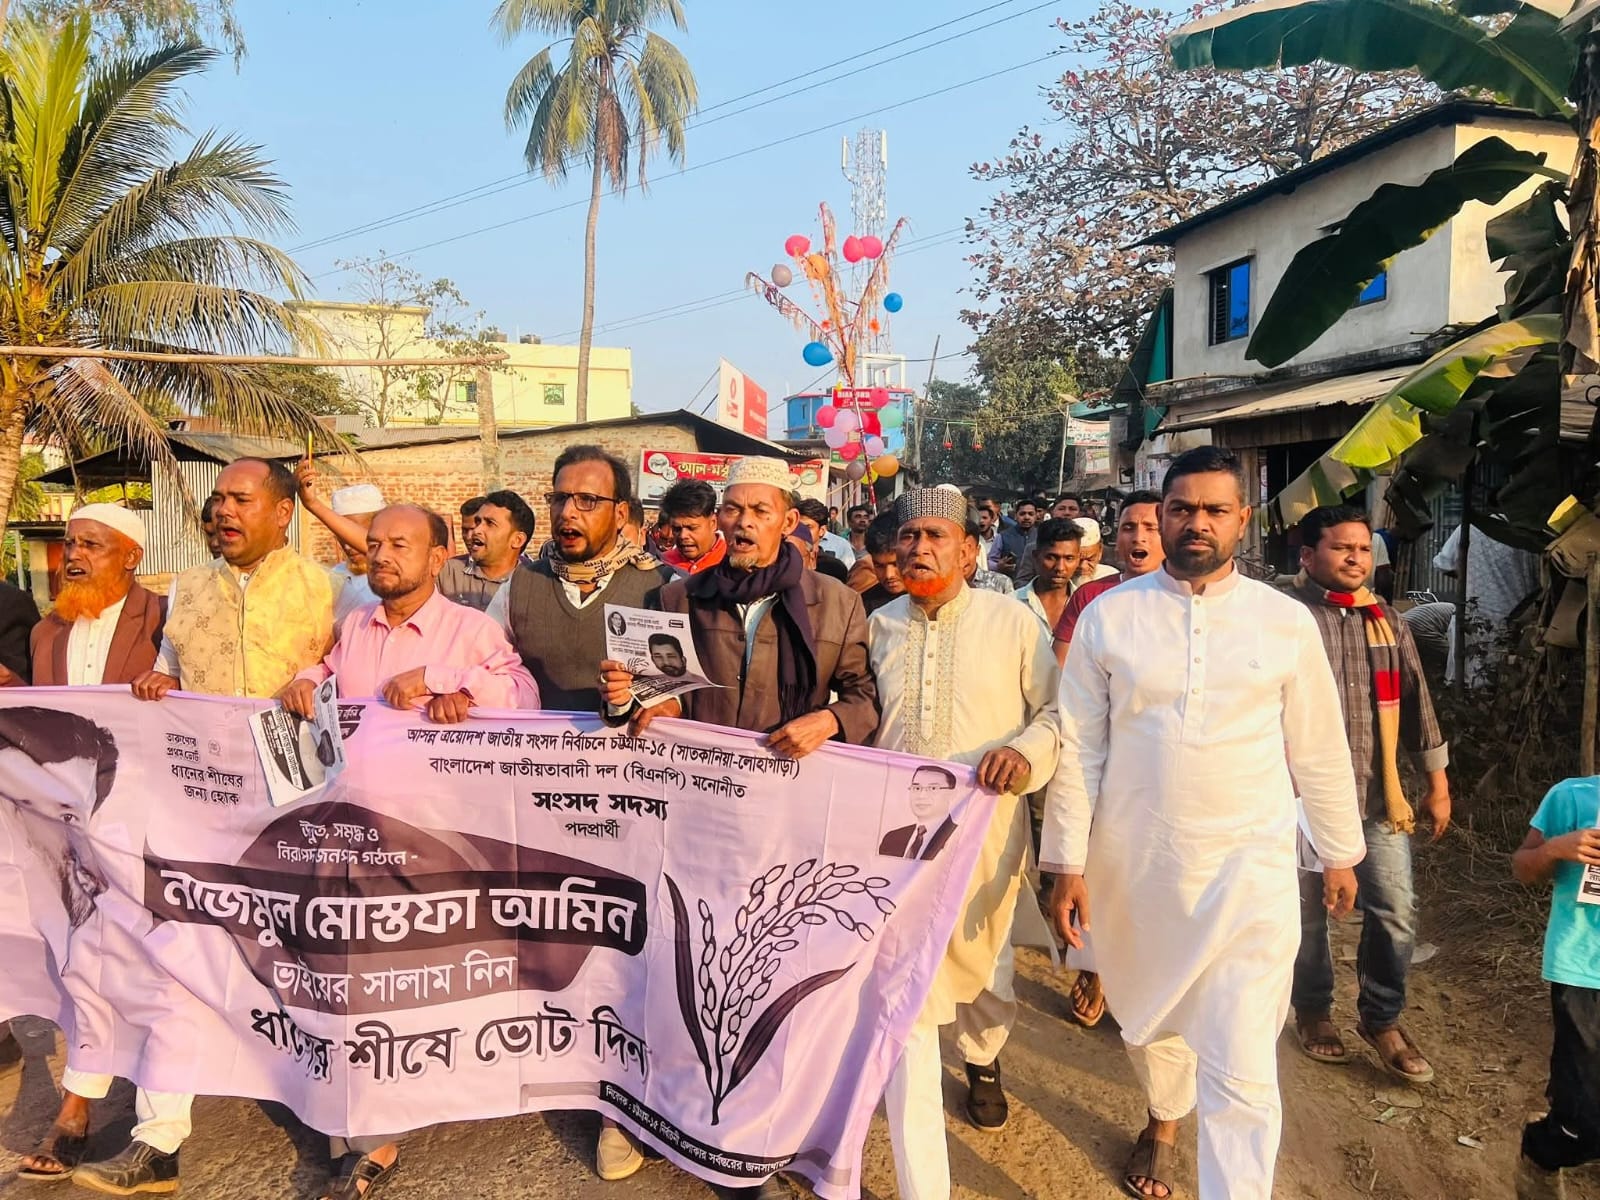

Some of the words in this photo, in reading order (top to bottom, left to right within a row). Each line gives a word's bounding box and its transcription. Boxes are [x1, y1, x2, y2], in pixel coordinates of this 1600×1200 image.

[407, 729, 440, 745] আসন্ন
[440, 730, 486, 745] ত্রয়োদশ
[487, 728, 524, 747] জাতীয়
[526, 733, 559, 750] সংসদ
[561, 731, 606, 751] নির্বাচনে
[171, 764, 205, 782] ধানের
[206, 766, 243, 788] শীষের
[429, 757, 495, 775] বাংলাদেশ
[499, 758, 591, 778] জাতীয়তাবাদী
[595, 764, 617, 778] দল
[623, 761, 687, 791] (বিএনপি)
[692, 774, 748, 799] মনোনীত
[184, 785, 208, 801] জন্য
[211, 790, 239, 805] হোক
[532, 791, 600, 814] সংসদ
[608, 793, 668, 821] সদস্য
[367, 828, 379, 842] ও
[565, 819, 620, 839] পদপ্রার্থী
[361, 848, 407, 866] গঠনে
[160, 869, 301, 948] নাজমুল
[303, 887, 482, 944] মোস্তফা
[488, 877, 638, 942] আমিন
[272, 955, 354, 1005] ভাইয়ের
[360, 960, 455, 1003] সালাম
[461, 949, 518, 993] নিন
[344, 1020, 460, 1080] শীষে
[475, 1001, 577, 1063] ভোট
[588, 1005, 648, 1077] দিন
